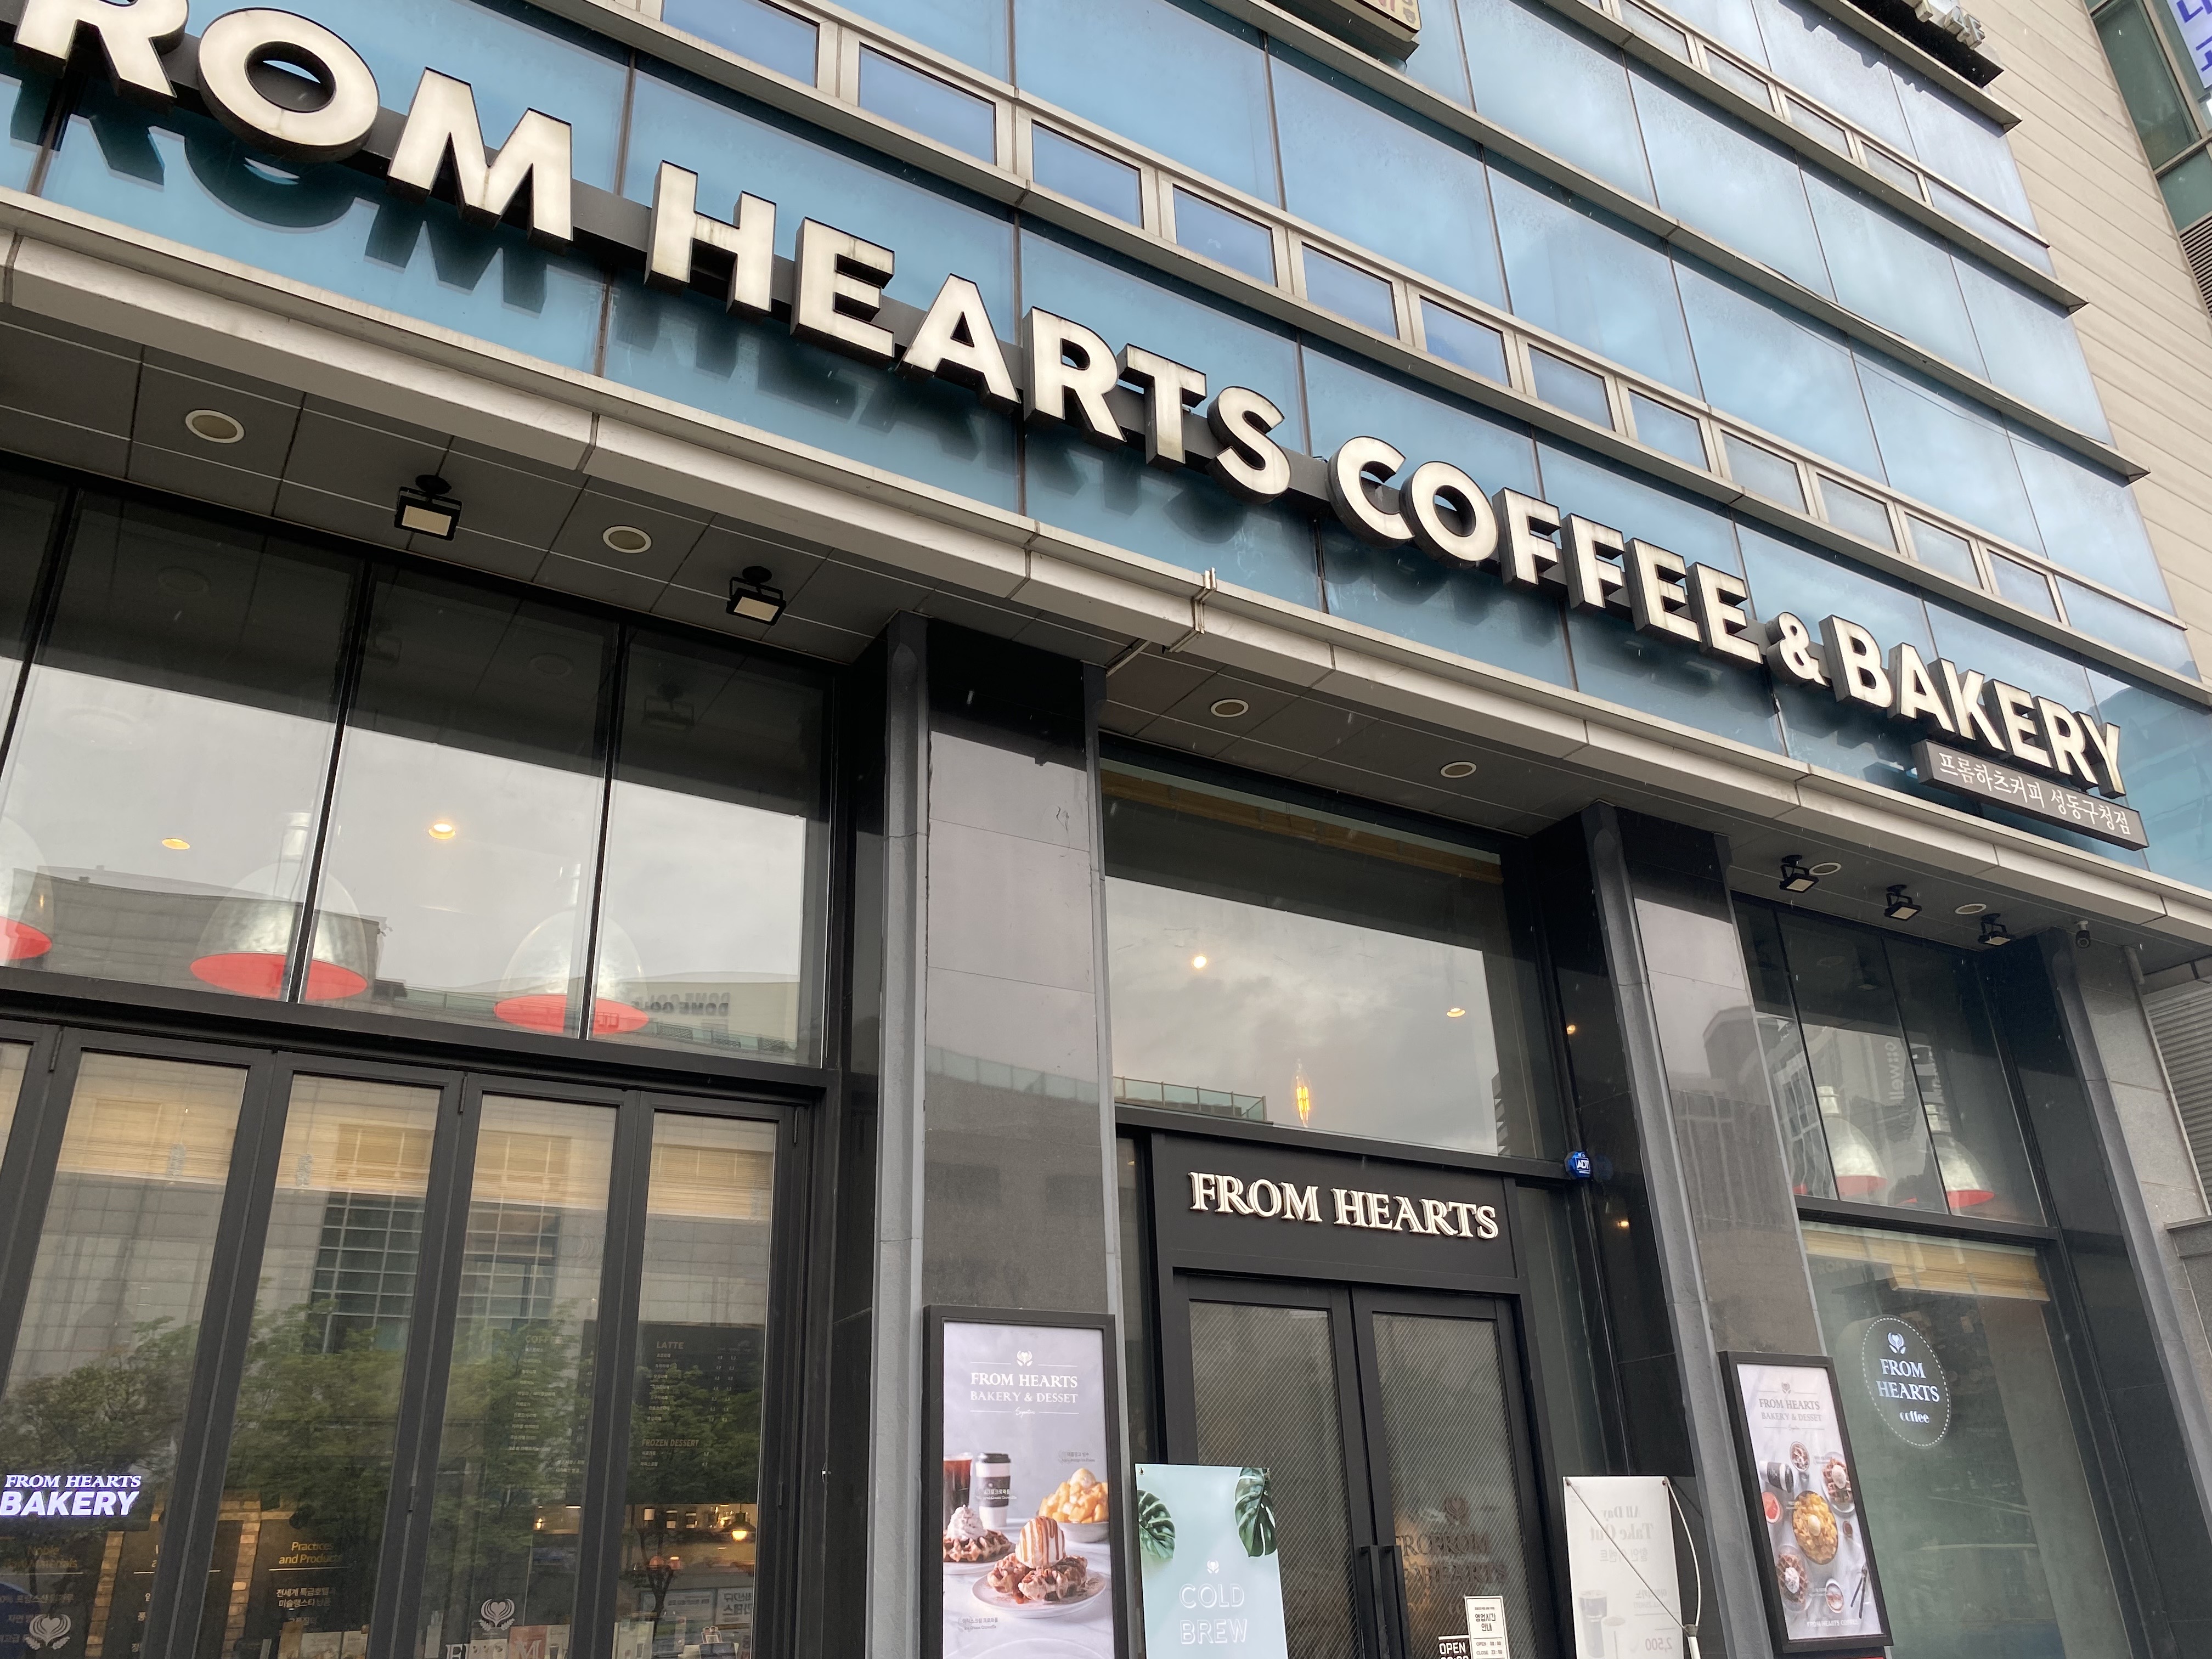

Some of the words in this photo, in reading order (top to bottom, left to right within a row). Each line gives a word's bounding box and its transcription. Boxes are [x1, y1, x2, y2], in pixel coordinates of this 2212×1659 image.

[644, 159, 1292, 500] HEARTS
[1327, 435, 1763, 665] COFFEE
[1766, 612, 1830, 687] &
[1818, 614, 2126, 798] BAKERY
[1938, 752, 2045, 809] 프롬하츠커피
[2050, 789, 2131, 836] 성동구청점
[1577, 1159, 1589, 1170] ADT
[1188, 1171, 1323, 1224] FROM
[1331, 1187, 1499, 1240] HEARTS
[656, 1341, 684, 1350] LATTE
[1880, 1358, 1926, 1379] FROM
[970, 1372, 1014, 1386] FROM
[1018, 1374, 1078, 1388] HEARTS
[970, 1391, 1021, 1402] BAKERY
[1024, 1392, 1032, 1402] &
[1036, 1392, 1078, 1403] DESSET
[1876, 1380, 1940, 1402] HEARTS
[1759, 1398, 1784, 1409] FROM
[1786, 1400, 1820, 1410] HEARTS
[1761, 1412, 1789, 1421] BAKERY
[1899, 1410, 1930, 1424] coffee
[641, 1438, 669, 1447] FROZEN
[4, 1475, 61, 1488] FROM
[65, 1475, 142, 1488] HEARTS
[0, 1491, 140, 1516] BAKERY
[279, 1554, 299, 1564] and
[1179, 1583, 1245, 1609] COLD
[1475, 1613, 1496, 1622] 영업시간
[1180, 1618, 1248, 1644] BREW
[1481, 1623, 1493, 1632] 안내
[1439, 1641, 1466, 1655] OPEN
